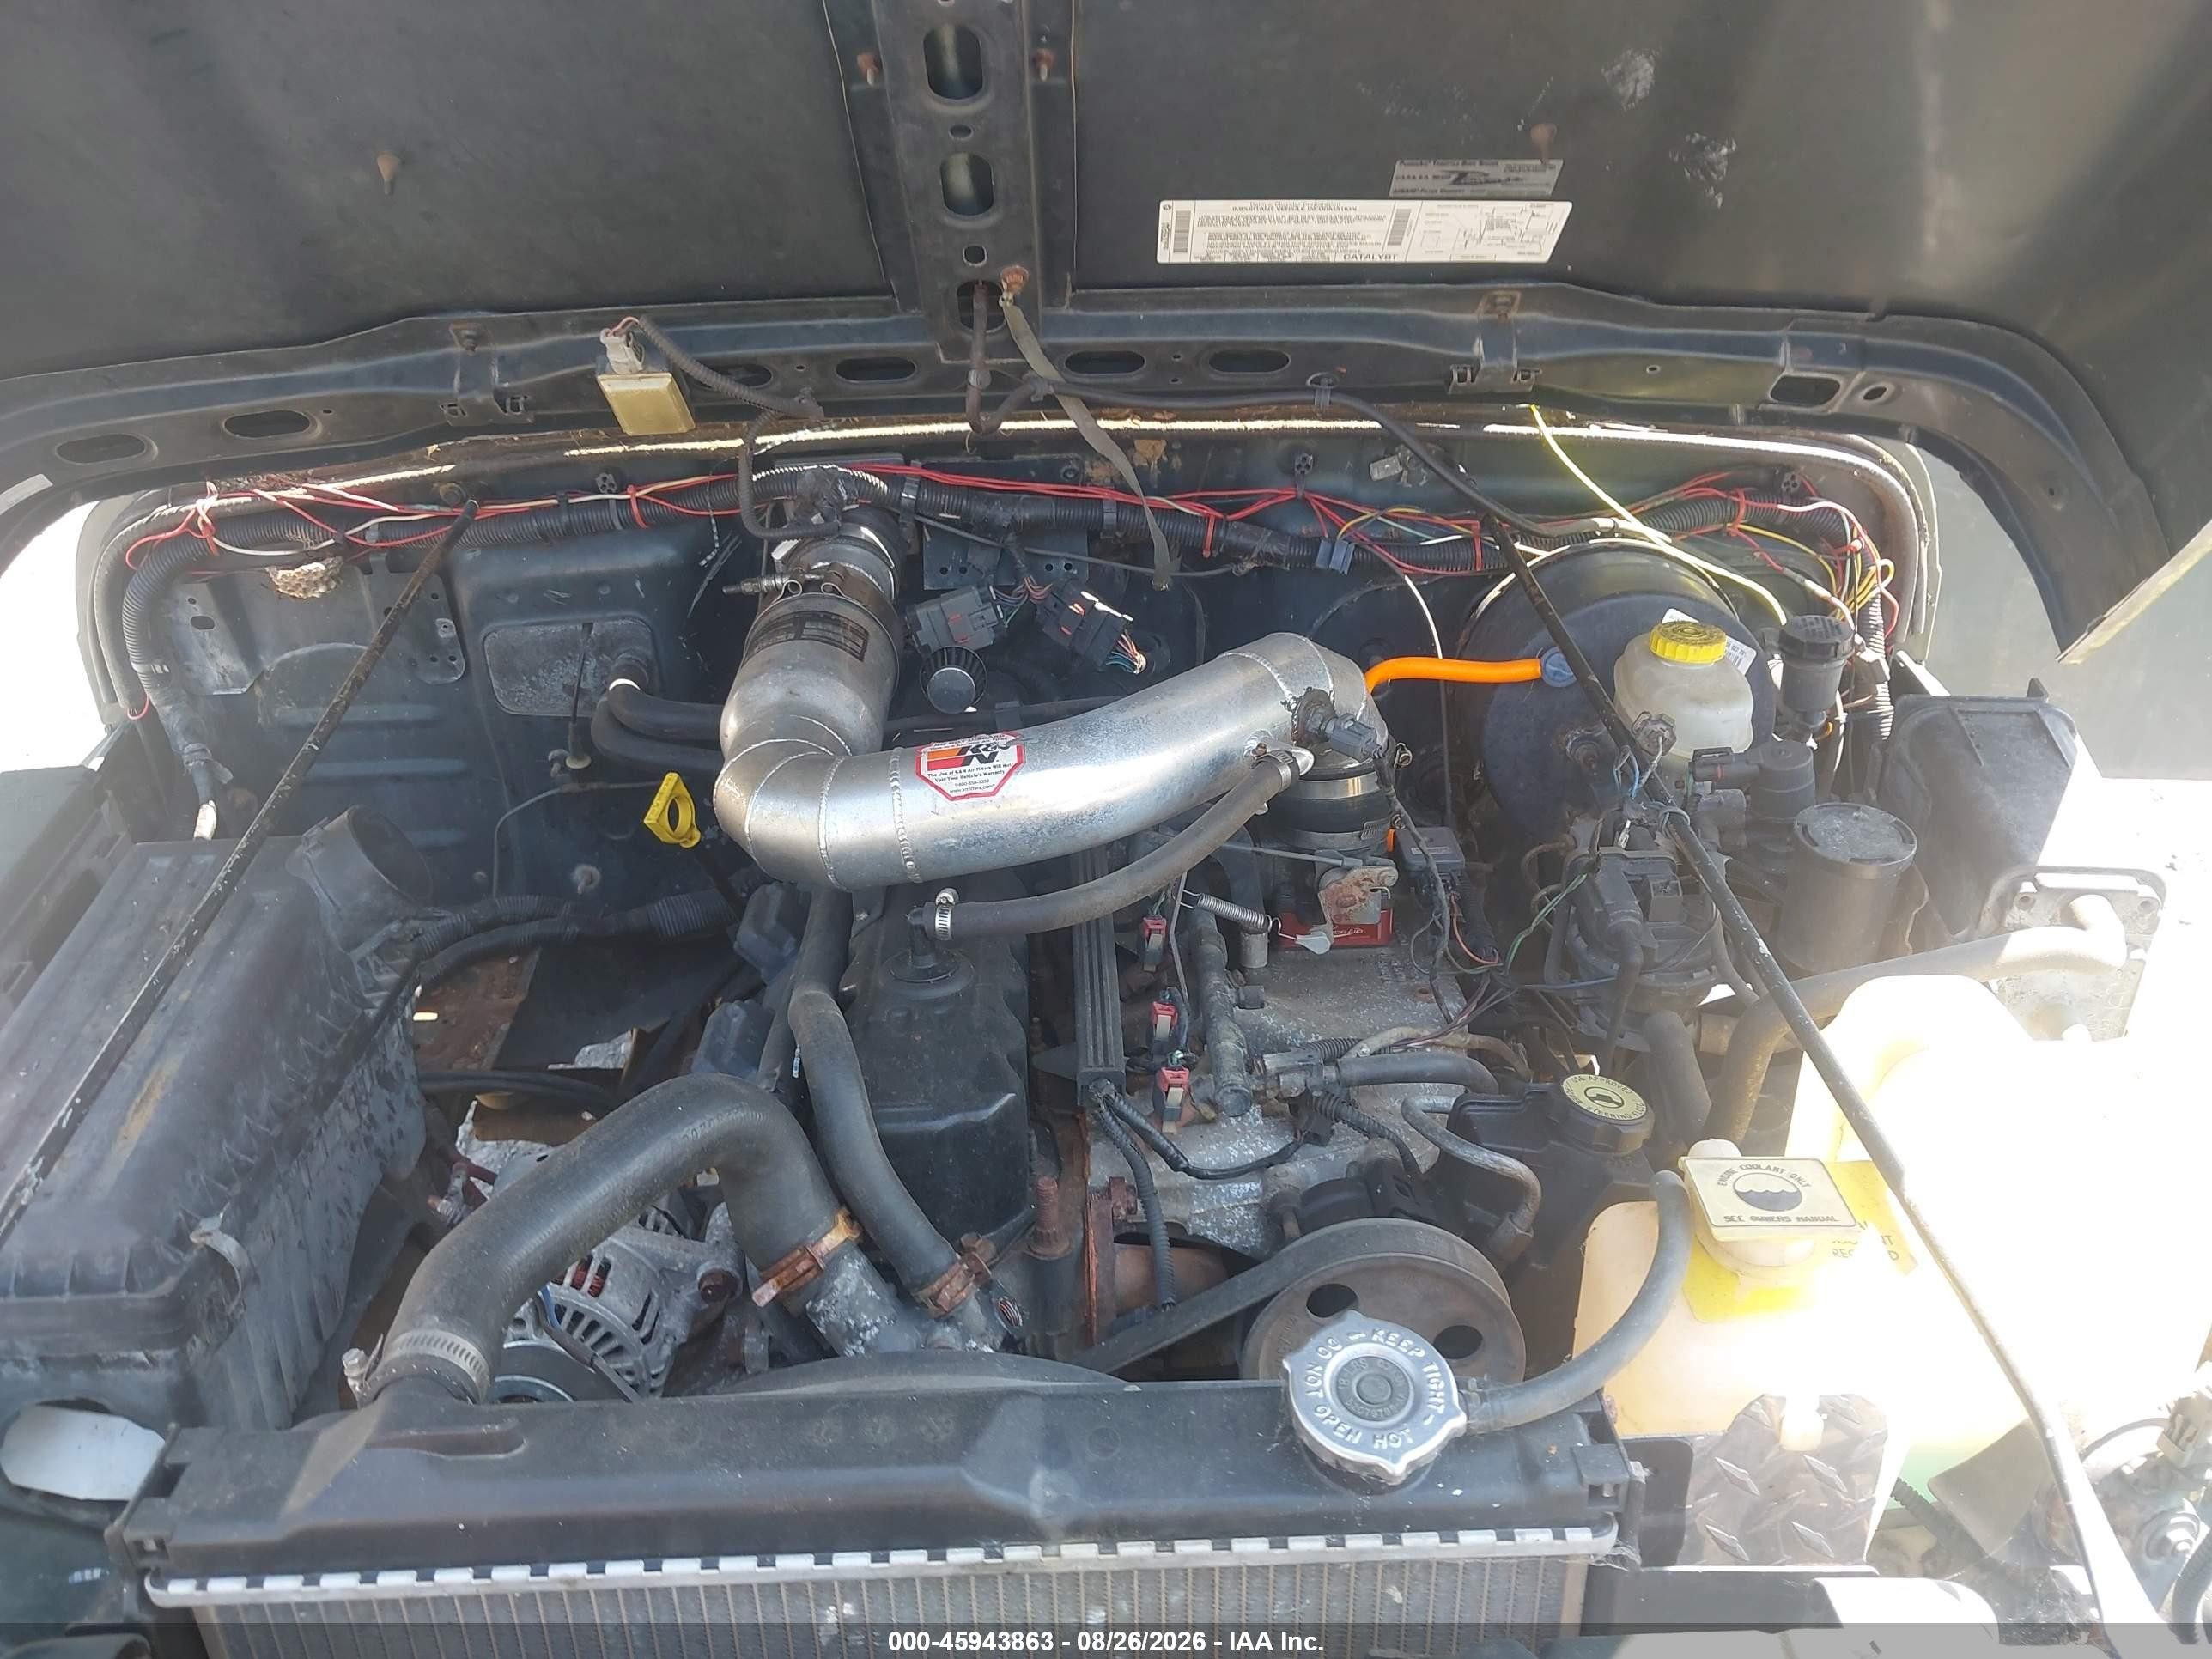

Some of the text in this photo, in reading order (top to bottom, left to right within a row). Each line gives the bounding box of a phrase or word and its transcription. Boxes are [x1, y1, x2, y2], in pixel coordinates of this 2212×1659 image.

[1589, 1076, 1632, 1094] APPROVED
[1587, 1105, 1632, 1119] STEERING
[1717, 1164, 1814, 1188] ENGINE COOLANT ONLY
[1316, 1338, 1343, 1360] DO
[1305, 1362, 1324, 1399] NOT
[1371, 1328, 1425, 1358] KEEP
[1422, 1361, 1446, 1414] TIGHT
[1314, 1405, 1363, 1445] OPEN
[1373, 1425, 1414, 1450] HOT
